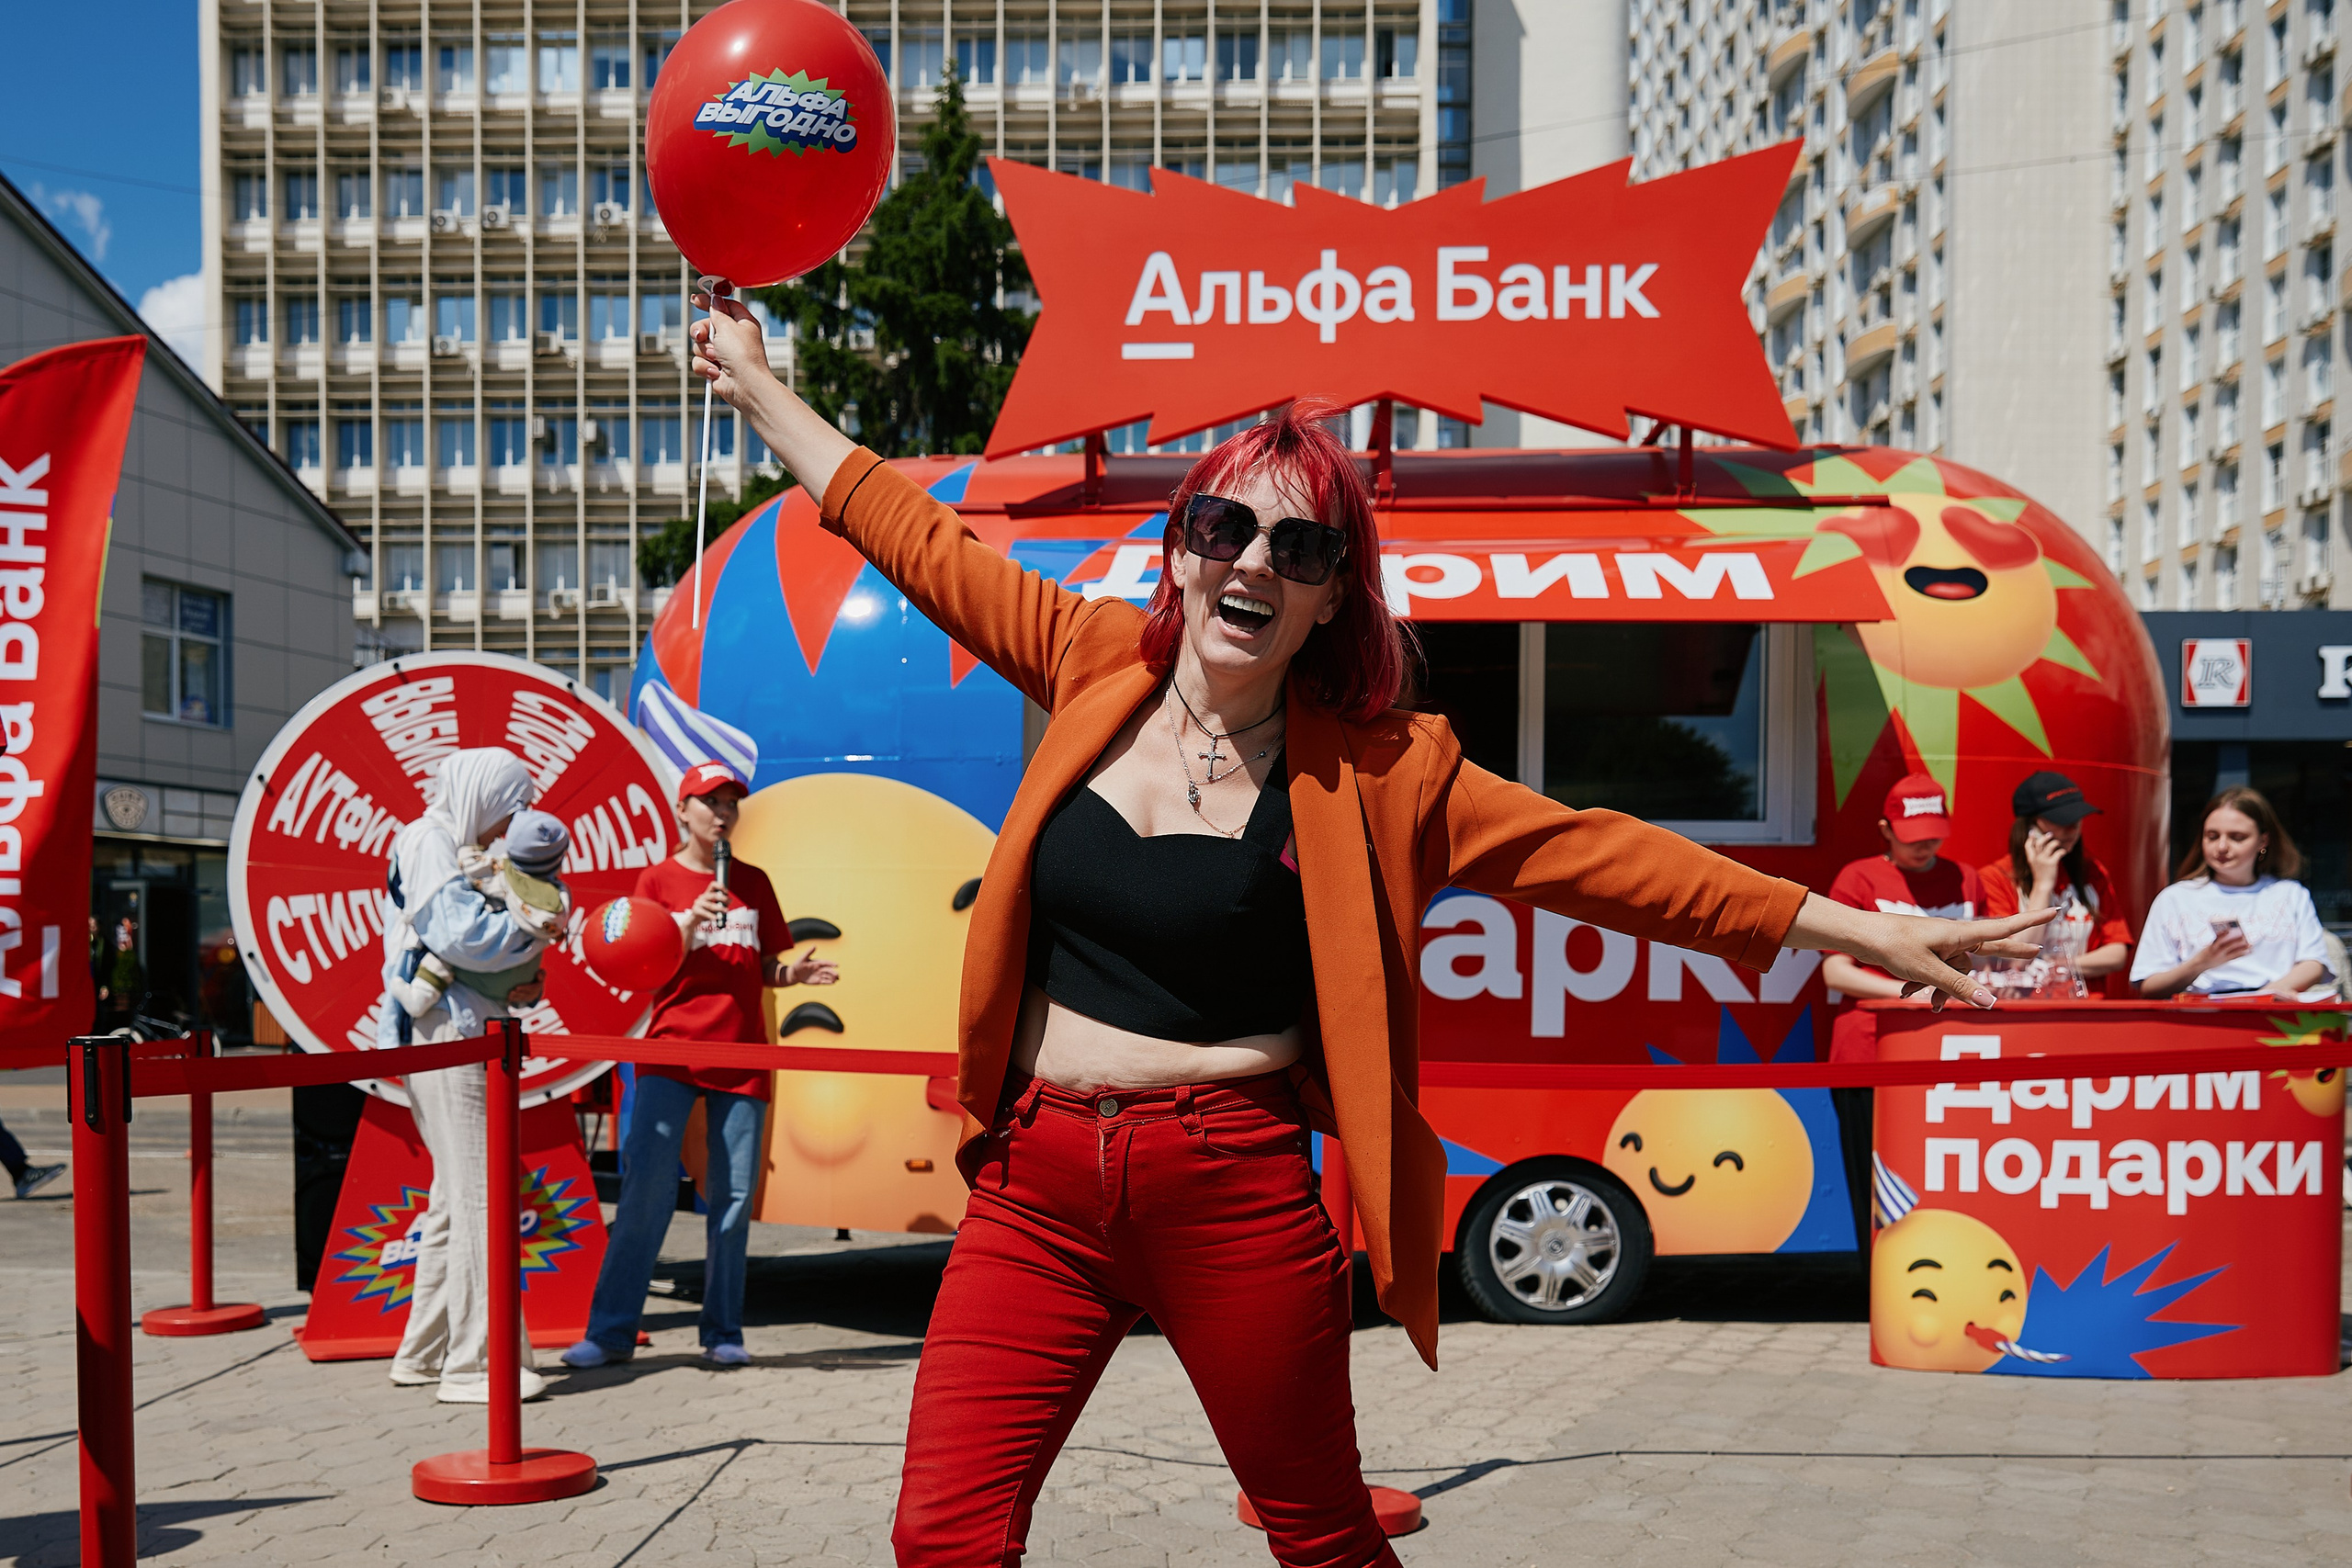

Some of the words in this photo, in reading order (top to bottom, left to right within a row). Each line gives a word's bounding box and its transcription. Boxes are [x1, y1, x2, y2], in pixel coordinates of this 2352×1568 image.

[695, 102, 856, 142] ВЫГОДНО
[726, 81, 847, 119] АЛЬФА
[1124, 249, 1415, 344] Альфа
[1436, 245, 1661, 321] Банк
[505, 690, 596, 806] СПОРТ
[561, 783, 668, 874] СТИЛ
[1925, 1137, 2324, 1216] подарки
